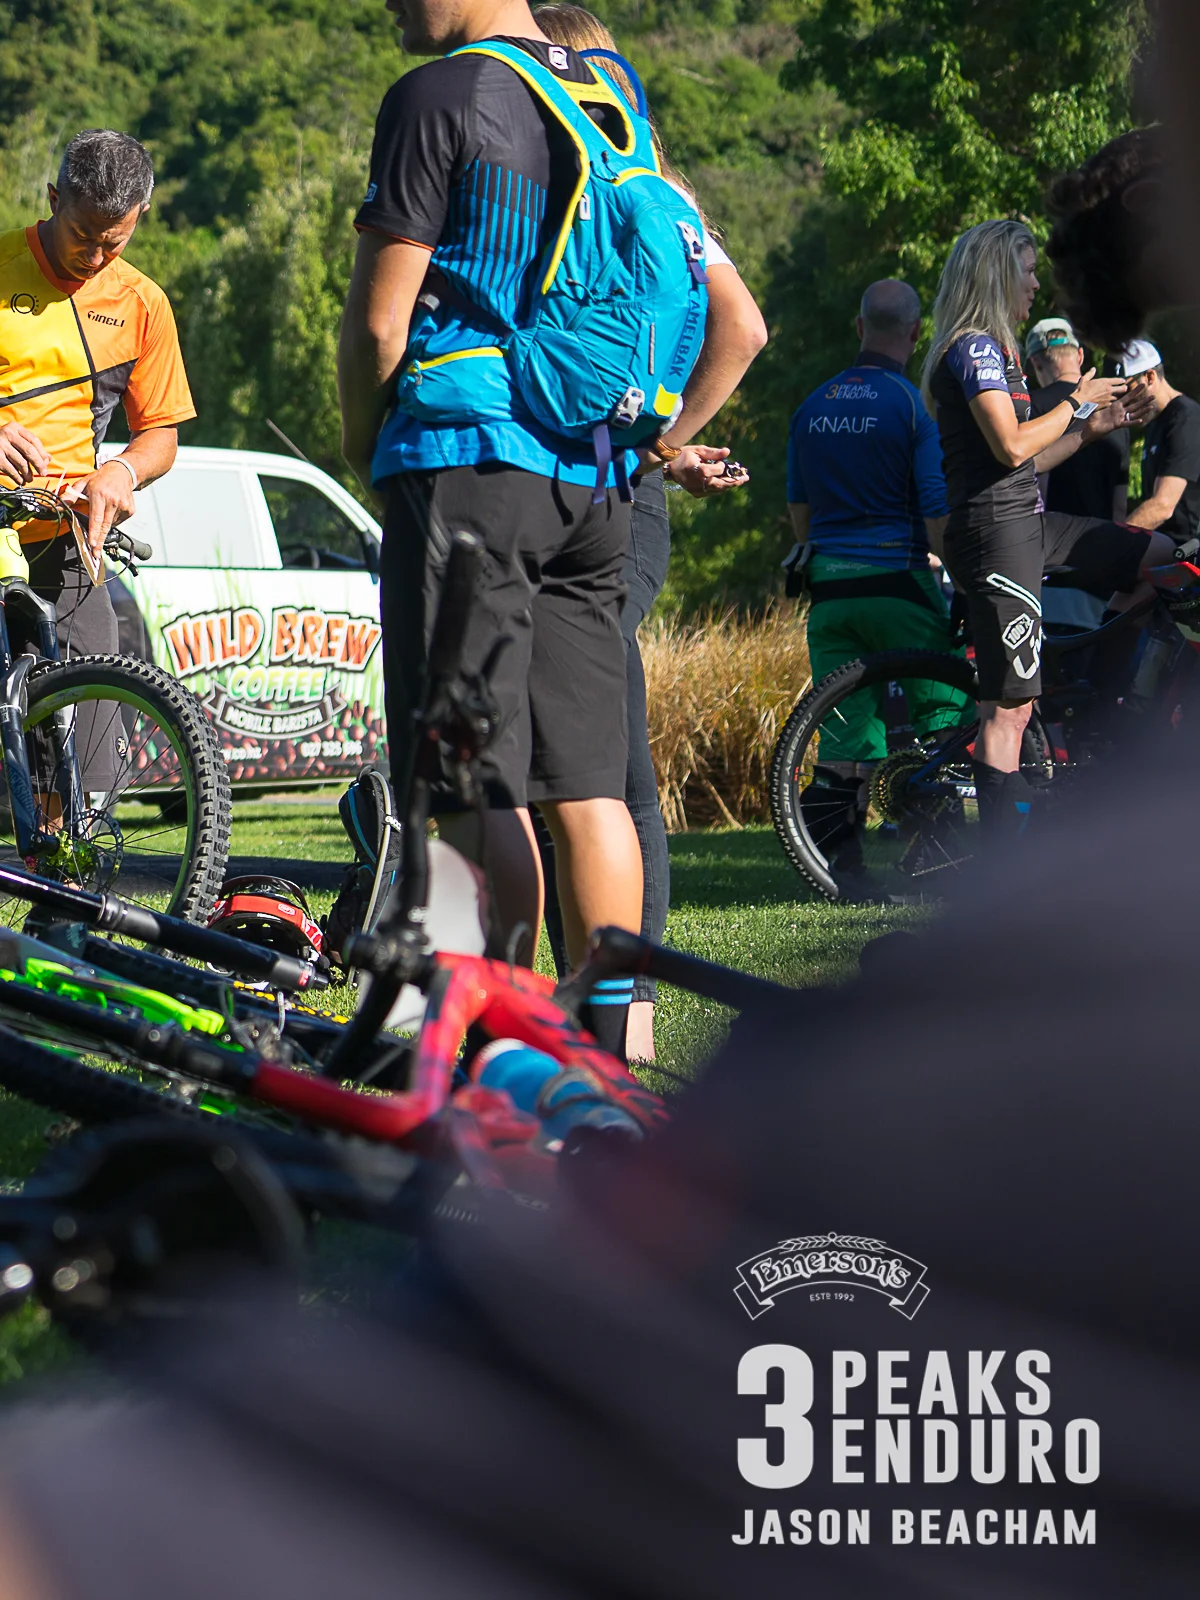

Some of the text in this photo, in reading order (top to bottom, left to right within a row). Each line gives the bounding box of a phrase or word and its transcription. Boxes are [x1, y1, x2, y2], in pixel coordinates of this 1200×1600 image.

[668, 288, 700, 377] CAMELBAK
[808, 416, 879, 434] KNAUF
[164, 608, 382, 675] WILD BREW
[229, 665, 325, 700] COFFEE
[225, 705, 323, 733] MOBILE BARISTA
